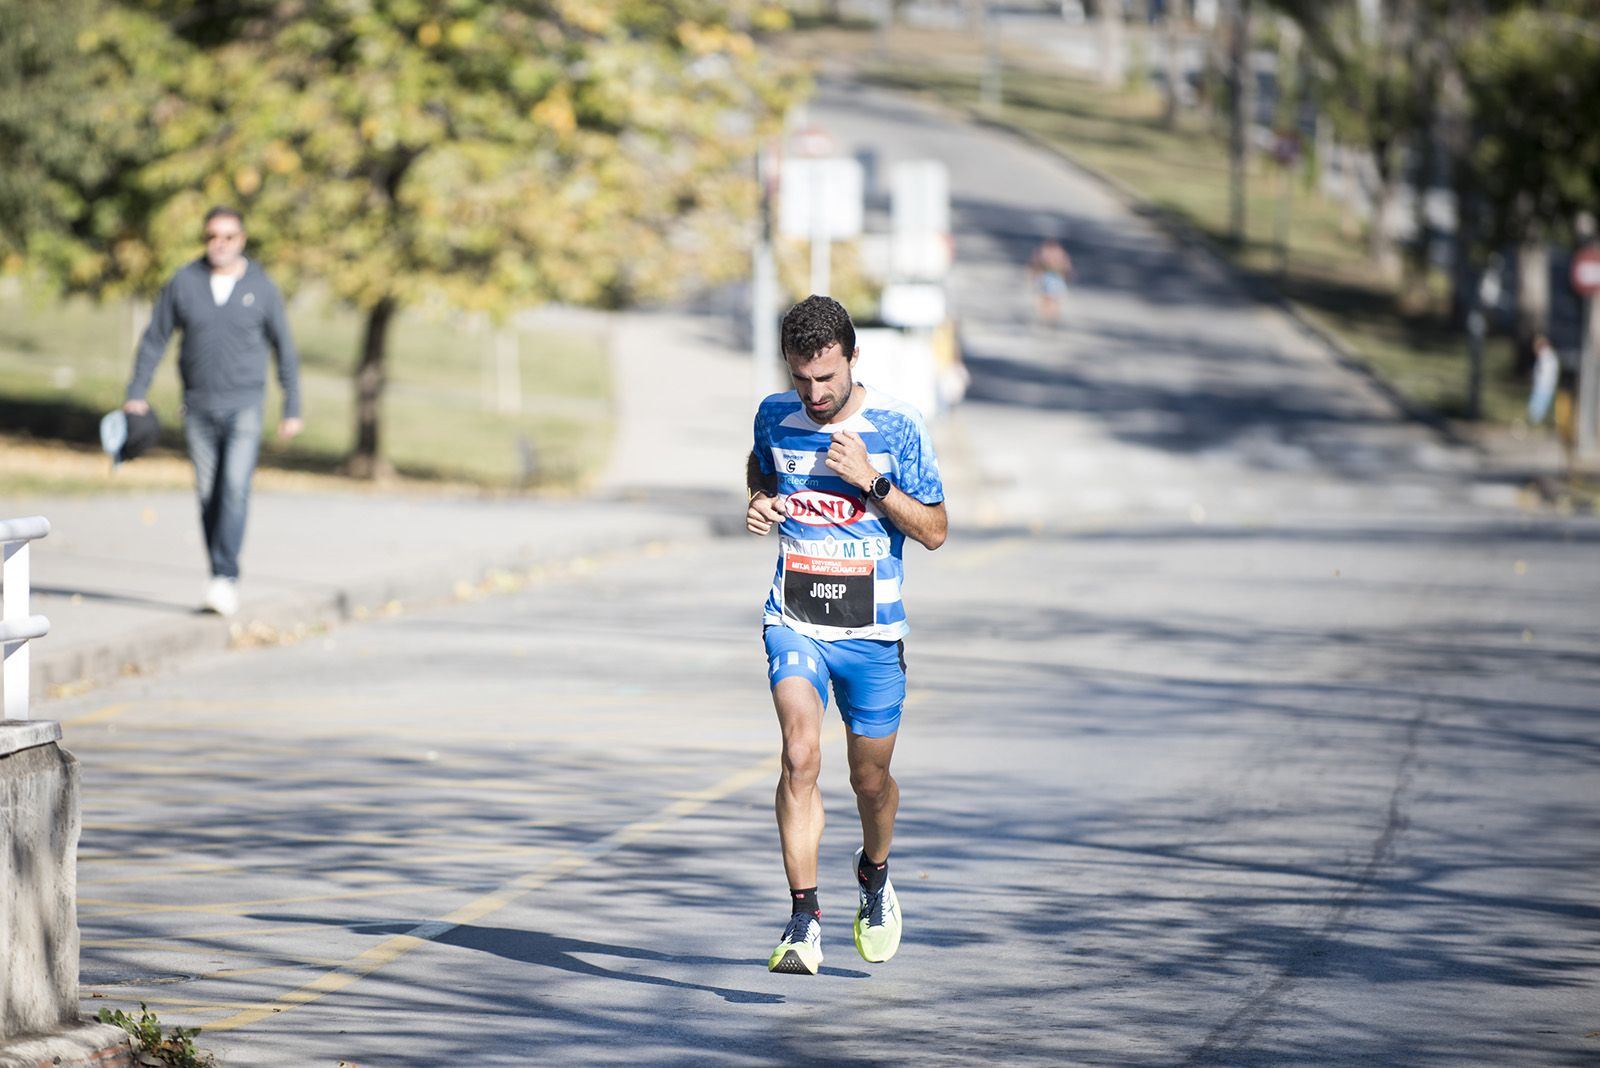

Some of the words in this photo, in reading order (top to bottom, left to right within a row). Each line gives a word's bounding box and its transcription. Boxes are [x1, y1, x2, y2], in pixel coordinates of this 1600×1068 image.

[790, 498, 845, 519] DANI
[811, 564, 830, 573] SANT
[810, 582, 847, 600] JOSEP
[824, 602, 830, 614] 1
